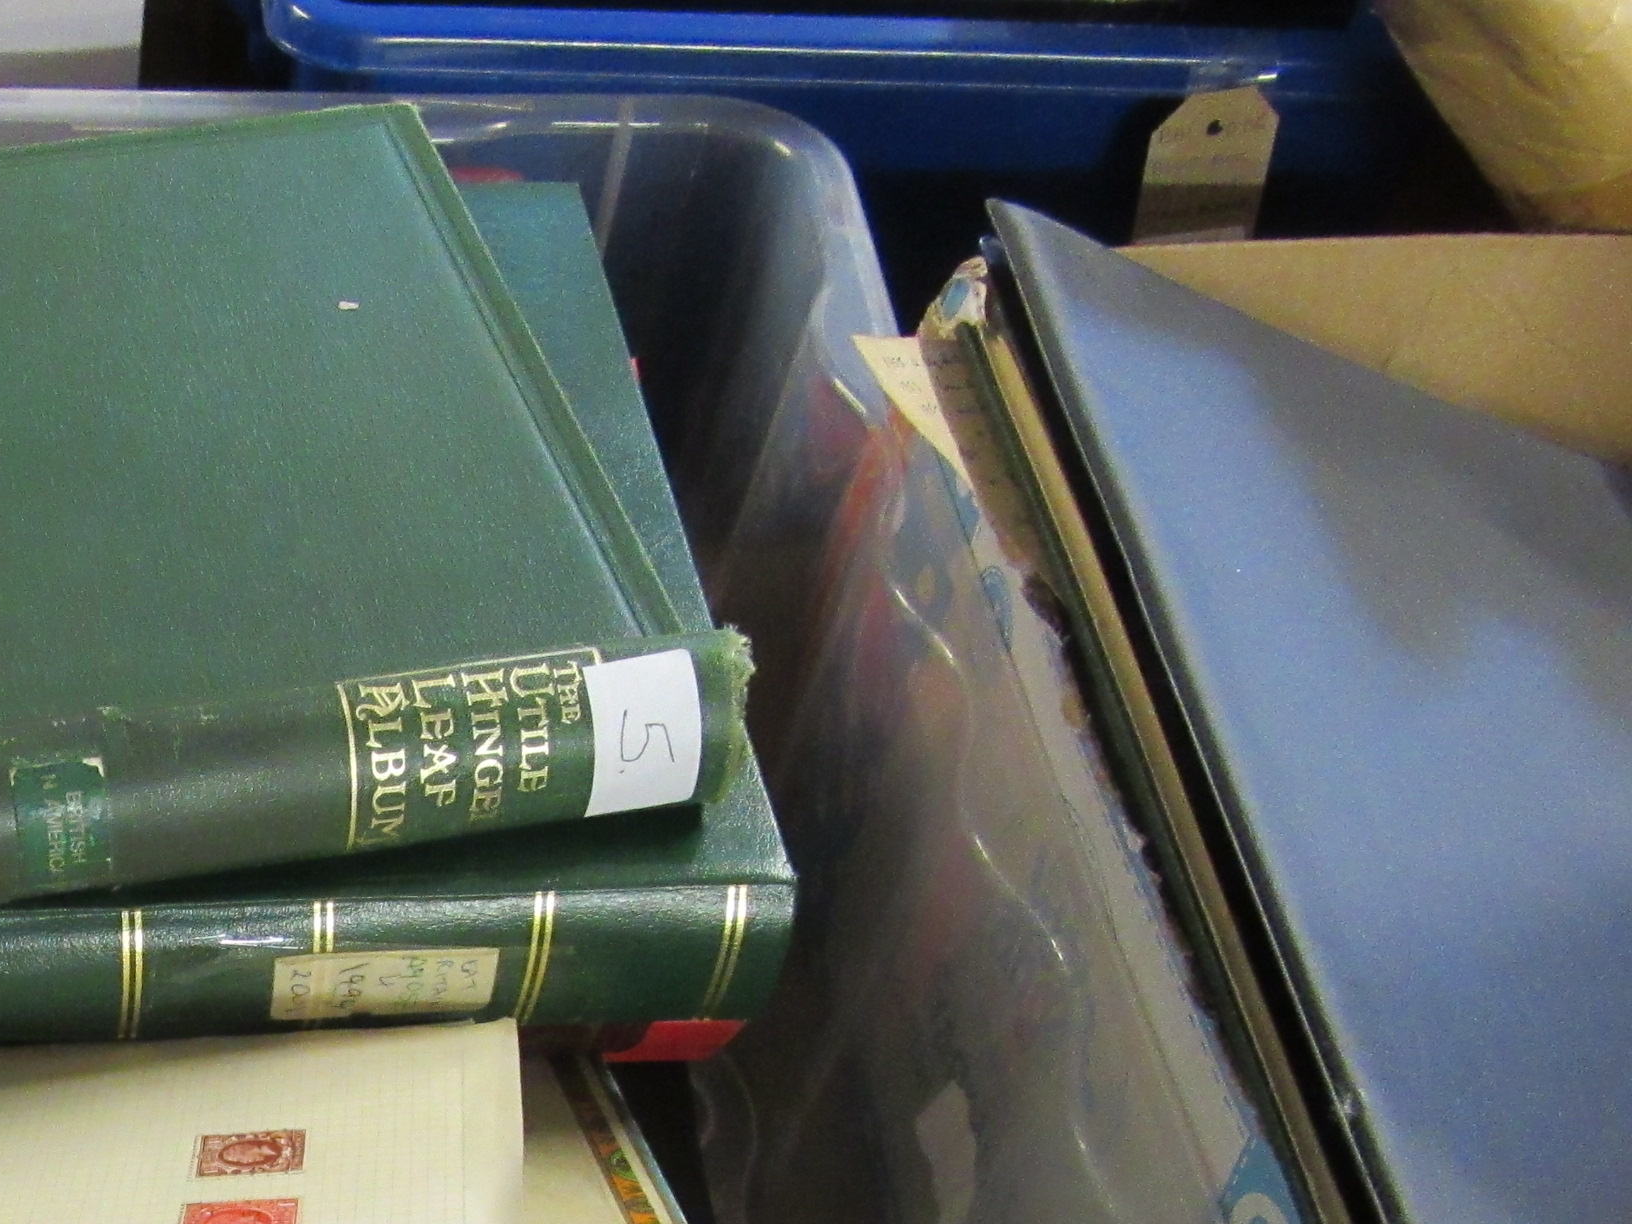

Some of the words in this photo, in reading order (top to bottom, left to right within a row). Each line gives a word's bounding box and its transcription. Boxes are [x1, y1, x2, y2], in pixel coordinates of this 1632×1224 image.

[411, 673, 460, 808] LEAF
[509, 662, 555, 794] UTILE
[552, 659, 583, 725] THE
[354, 682, 409, 845] ALBUM
